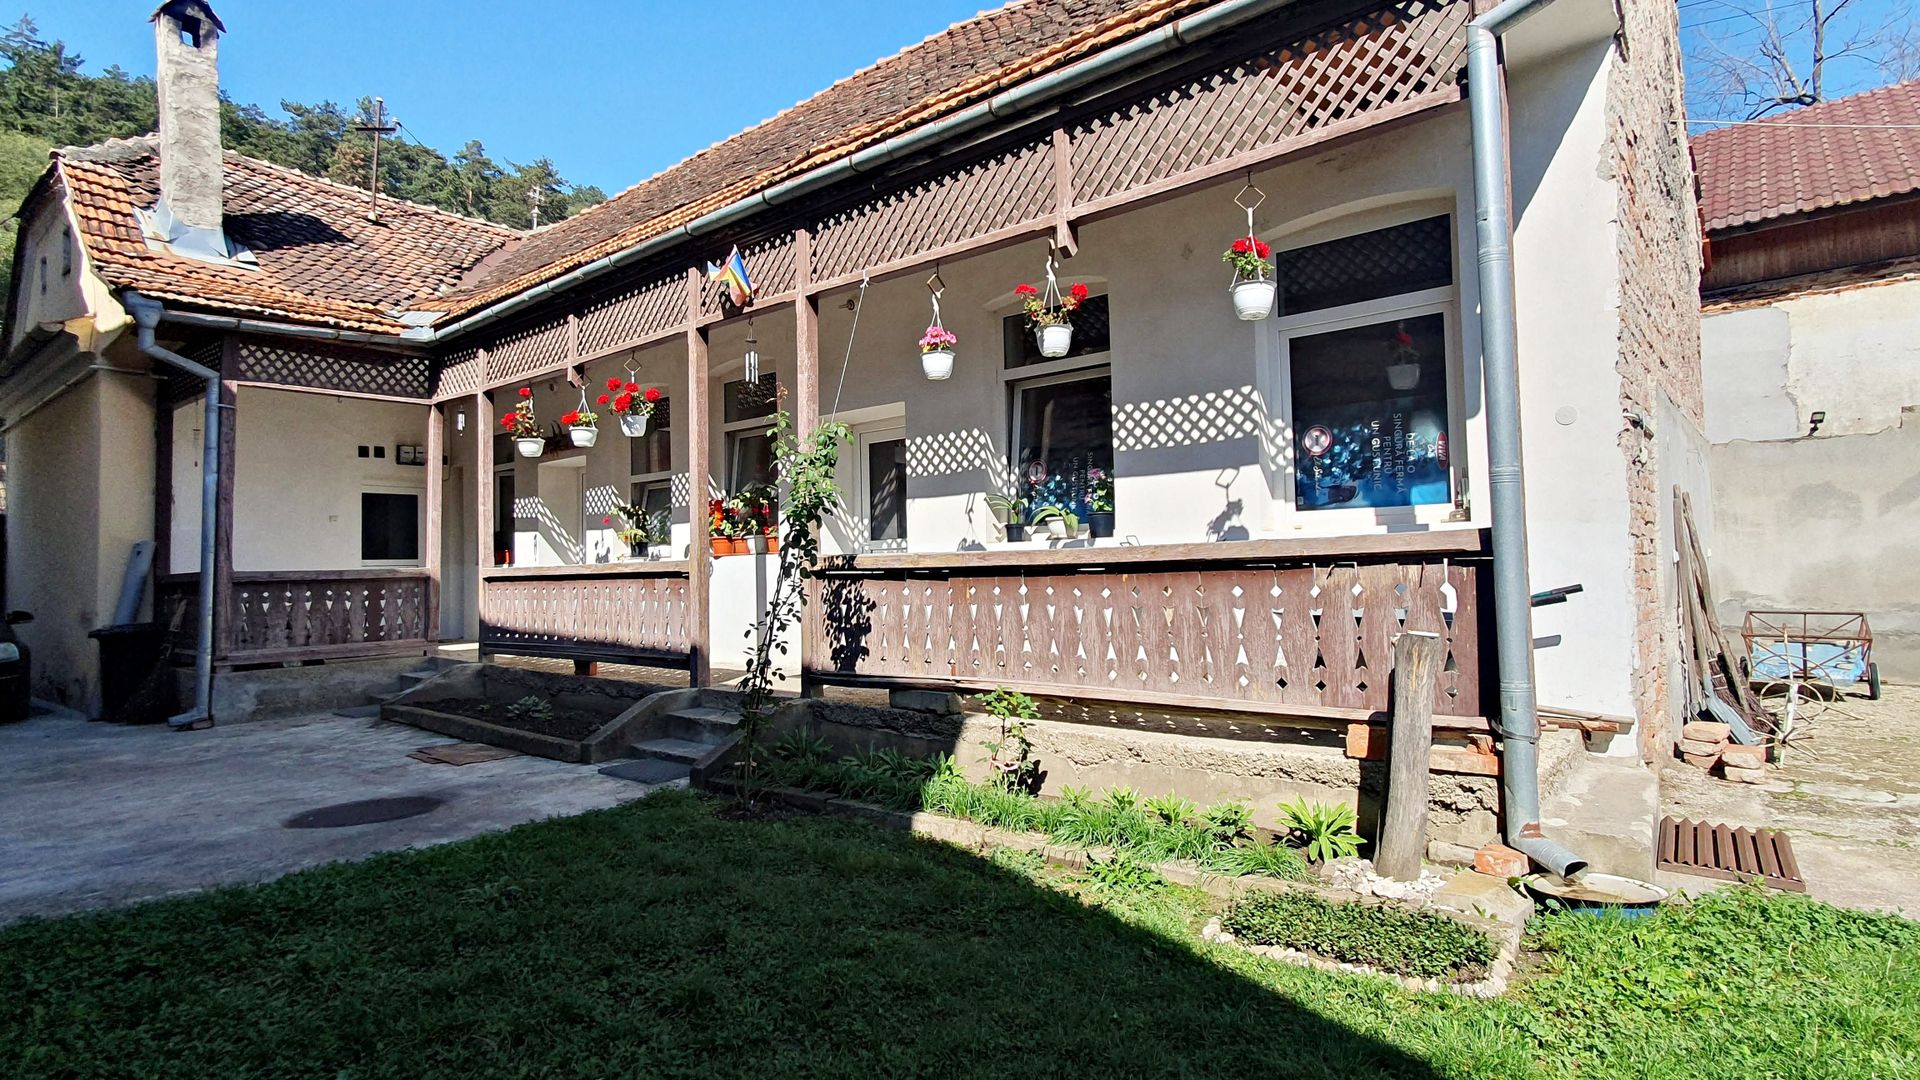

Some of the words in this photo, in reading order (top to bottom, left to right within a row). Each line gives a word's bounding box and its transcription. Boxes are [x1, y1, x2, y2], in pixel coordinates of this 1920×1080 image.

[1371, 420, 1380, 435] UN
[1371, 438, 1381, 464] GUST
[1383, 436, 1393, 474] PENTRU
[1438, 440, 1447, 461] VIVA
[1372, 466, 1382, 490] UNIC
[1407, 465, 1416, 474] O
